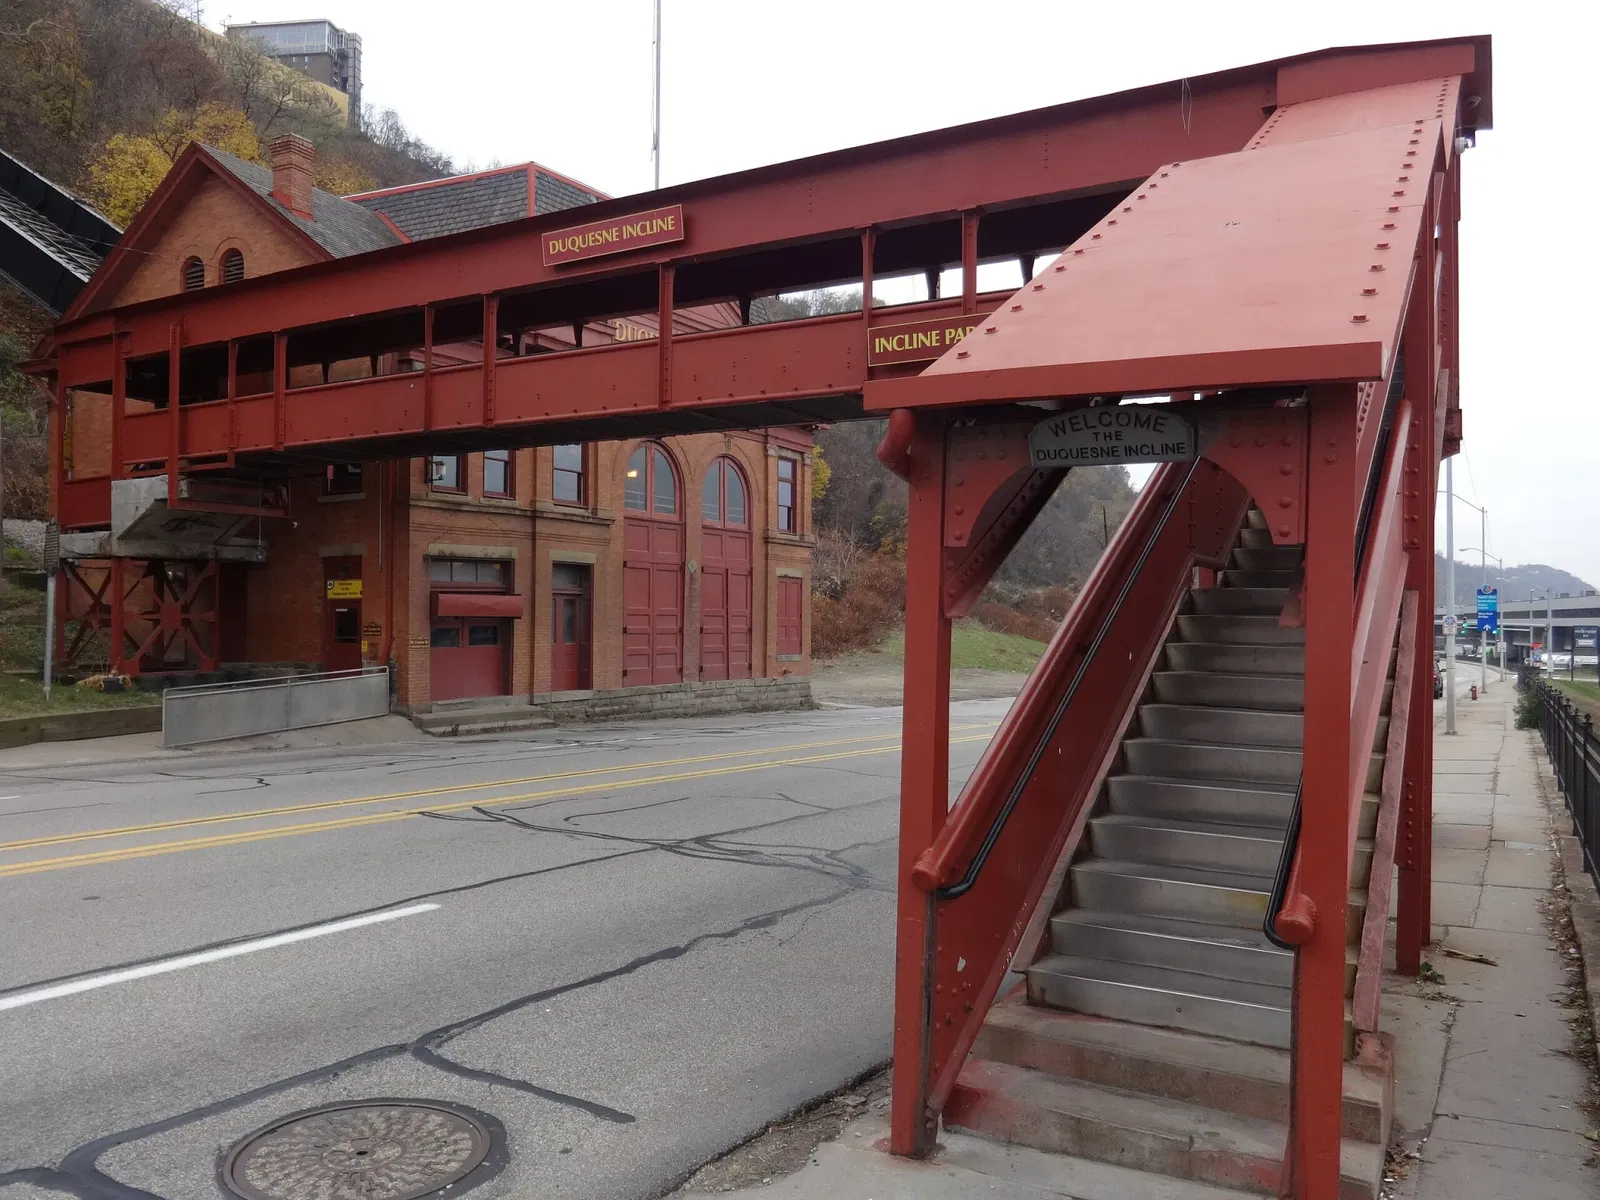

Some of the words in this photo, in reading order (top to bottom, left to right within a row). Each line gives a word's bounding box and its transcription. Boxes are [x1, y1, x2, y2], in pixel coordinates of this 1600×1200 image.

[548, 227, 619, 255] DUQUESNE
[622, 215, 675, 240] INCLINE
[874, 330, 940, 353] INCLINE
[1047, 410, 1169, 438] WELCOME
[1092, 431, 1124, 442] THE
[1036, 445, 1121, 461] DUQUESNE
[1124, 442, 1187, 457] INCLINE
